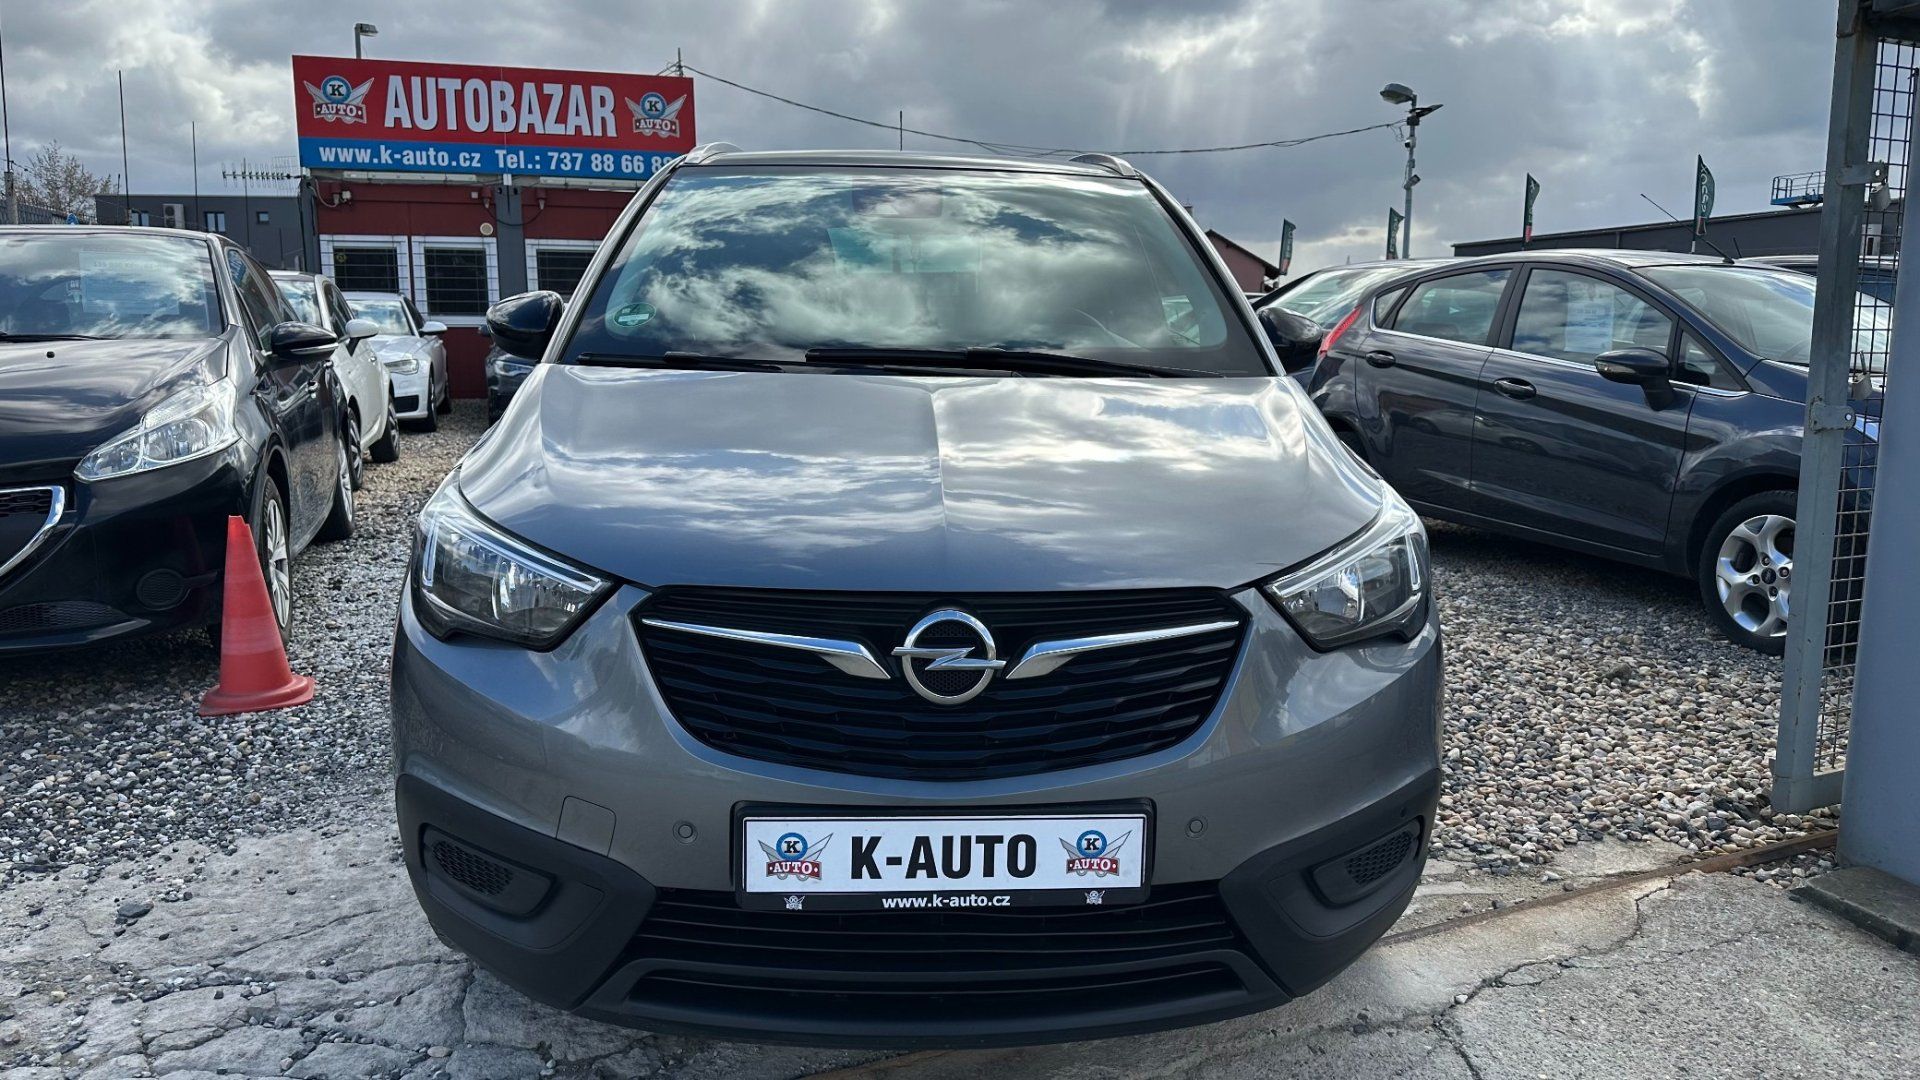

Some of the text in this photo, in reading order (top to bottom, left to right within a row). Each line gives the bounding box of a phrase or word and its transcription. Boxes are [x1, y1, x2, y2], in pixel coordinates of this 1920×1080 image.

[329, 84, 344, 96] K
[320, 104, 357, 116] AUTO
[384, 74, 618, 138] AUTOBAZAR
[647, 100, 660, 112] K
[639, 119, 671, 131] AUTO
[318, 145, 482, 167] www.k-auto.cz
[495, 150, 541, 169] Tel.:
[547, 152, 583, 171] 737
[591, 153, 614, 172] 88
[621, 154, 645, 174] 66
[784, 840, 800, 853] K
[1084, 837, 1100, 850] K
[851, 834, 1037, 879] K-AUTO
[773, 862, 813, 874] AUTO
[1073, 858, 1111, 871] AUTO
[882, 894, 1011, 908] www.k-auto.cz
